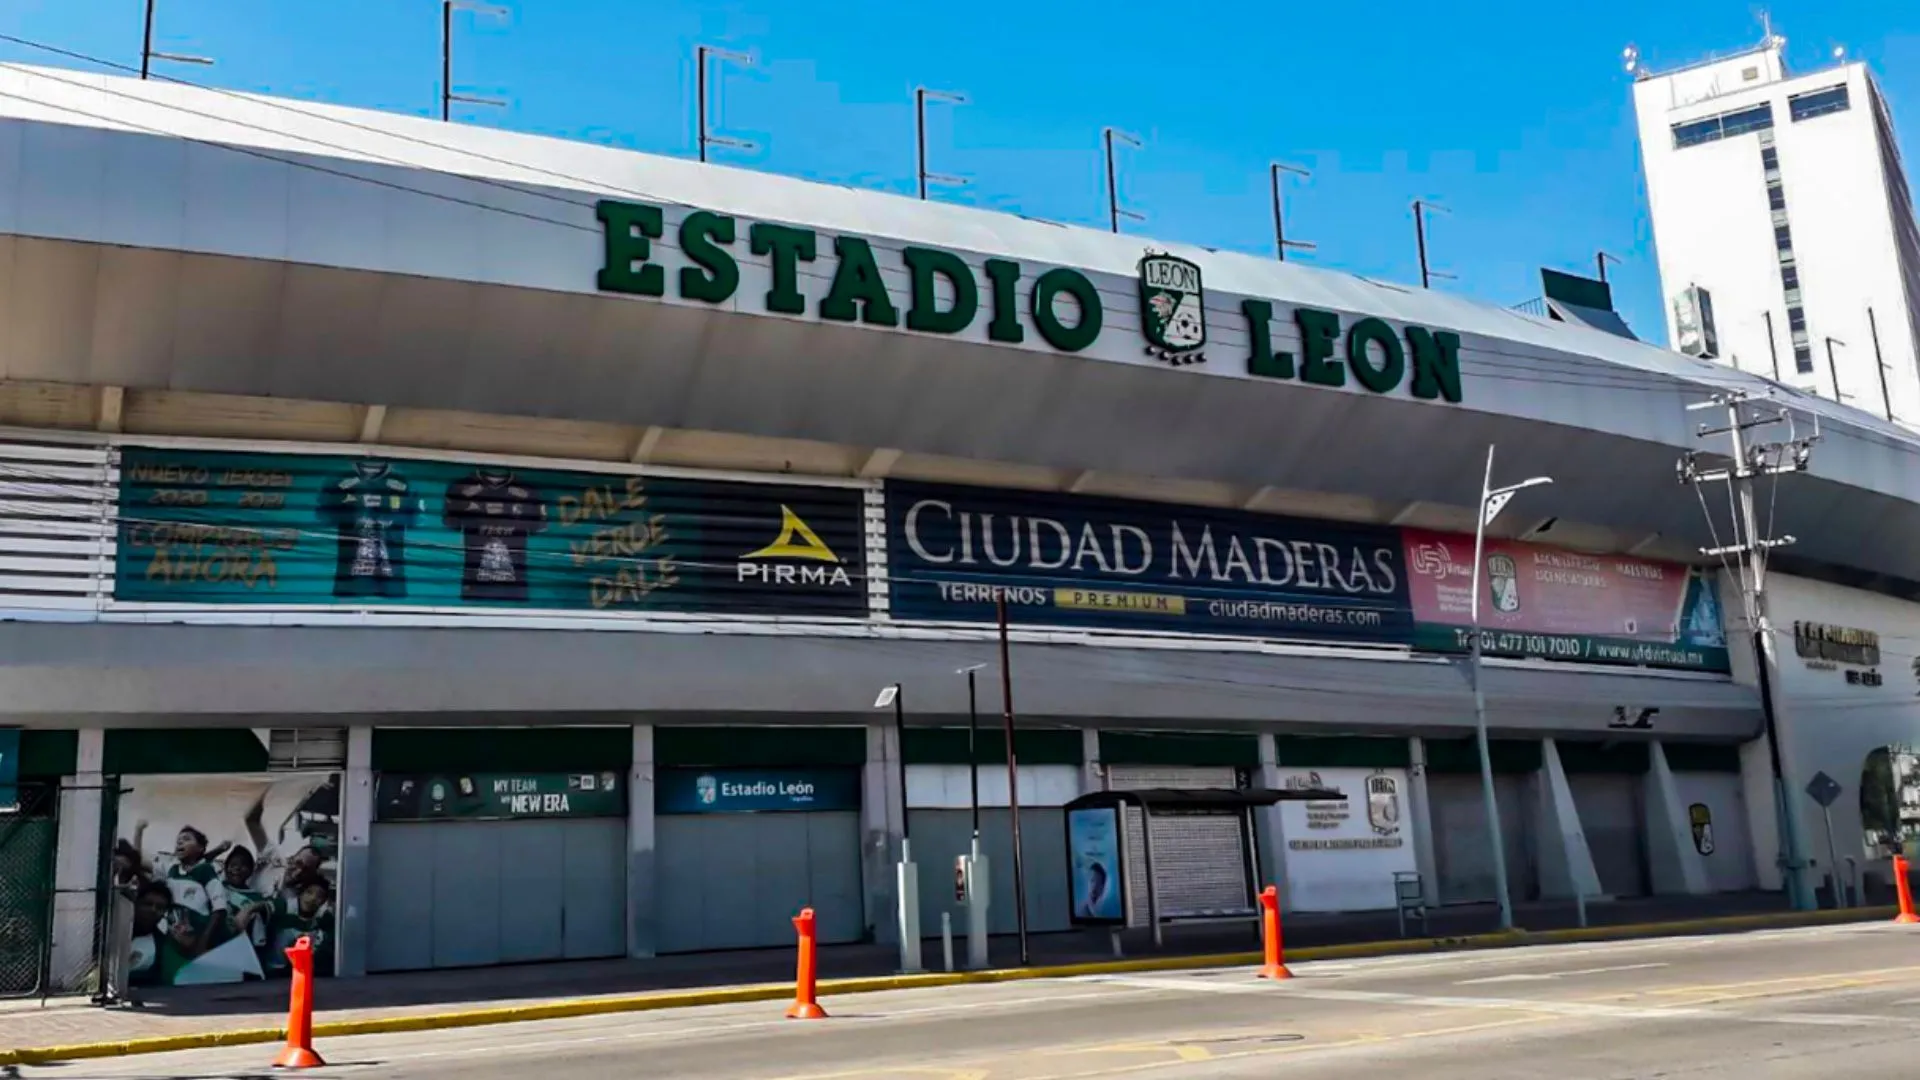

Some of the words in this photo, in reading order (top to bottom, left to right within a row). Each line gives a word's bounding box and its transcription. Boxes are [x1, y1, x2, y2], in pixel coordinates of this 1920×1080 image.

[1148, 262, 1196, 289] LEON
[596, 200, 1103, 354] ESTADIO
[1242, 299, 1461, 403] LEON
[130, 464, 209, 484] NUEVO
[557, 477, 649, 527] DALE
[570, 514, 671, 567] VERDE
[904, 499, 1153, 575] CIUDAD
[1167, 520, 1397, 594] MADERAS
[146, 549, 277, 588] AHORA
[589, 555, 681, 608] DALE
[737, 562, 852, 587] PIRMA
[938, 581, 1047, 606] TERRENOS
[1073, 591, 1169, 611] PREMIUM
[1208, 598, 1381, 625] ciudadmaderas.com
[1498, 632, 1523, 652] 477
[1525, 635, 1546, 653] 101
[1549, 637, 1580, 656] 7010
[494, 778, 509, 793] MY
[511, 778, 537, 793] TEAM
[721, 781, 776, 797] Estadio
[779, 779, 815, 796] León
[511, 794, 540, 813] NEW
[543, 793, 570, 813] ERA
